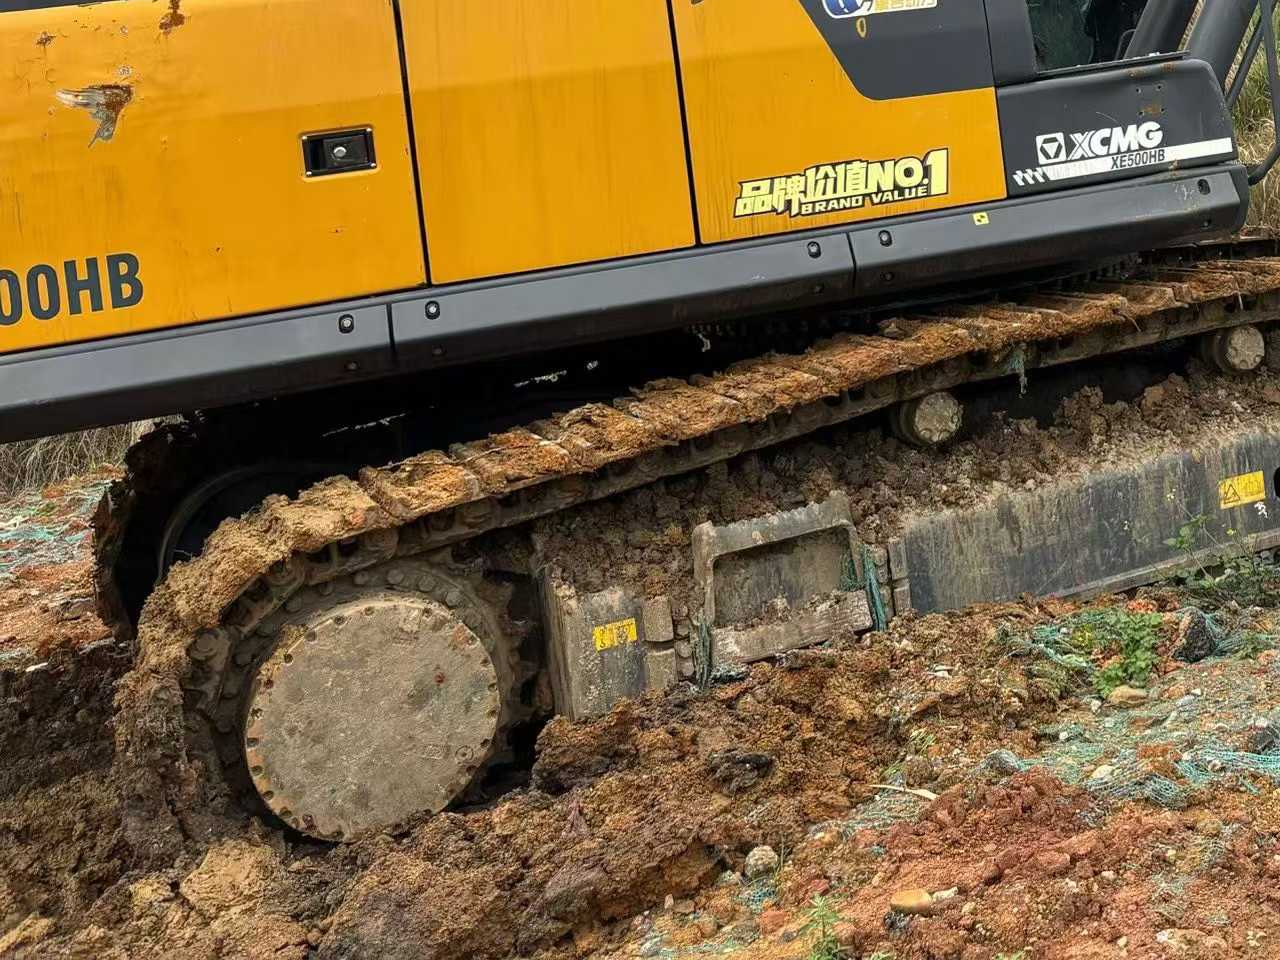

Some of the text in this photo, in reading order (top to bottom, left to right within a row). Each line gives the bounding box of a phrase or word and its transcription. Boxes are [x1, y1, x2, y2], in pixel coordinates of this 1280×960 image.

[1067, 121, 1163, 160] XCMG
[1111, 149, 1166, 169] XE500HB
[801, 186, 928, 214] BRAND VALUE
